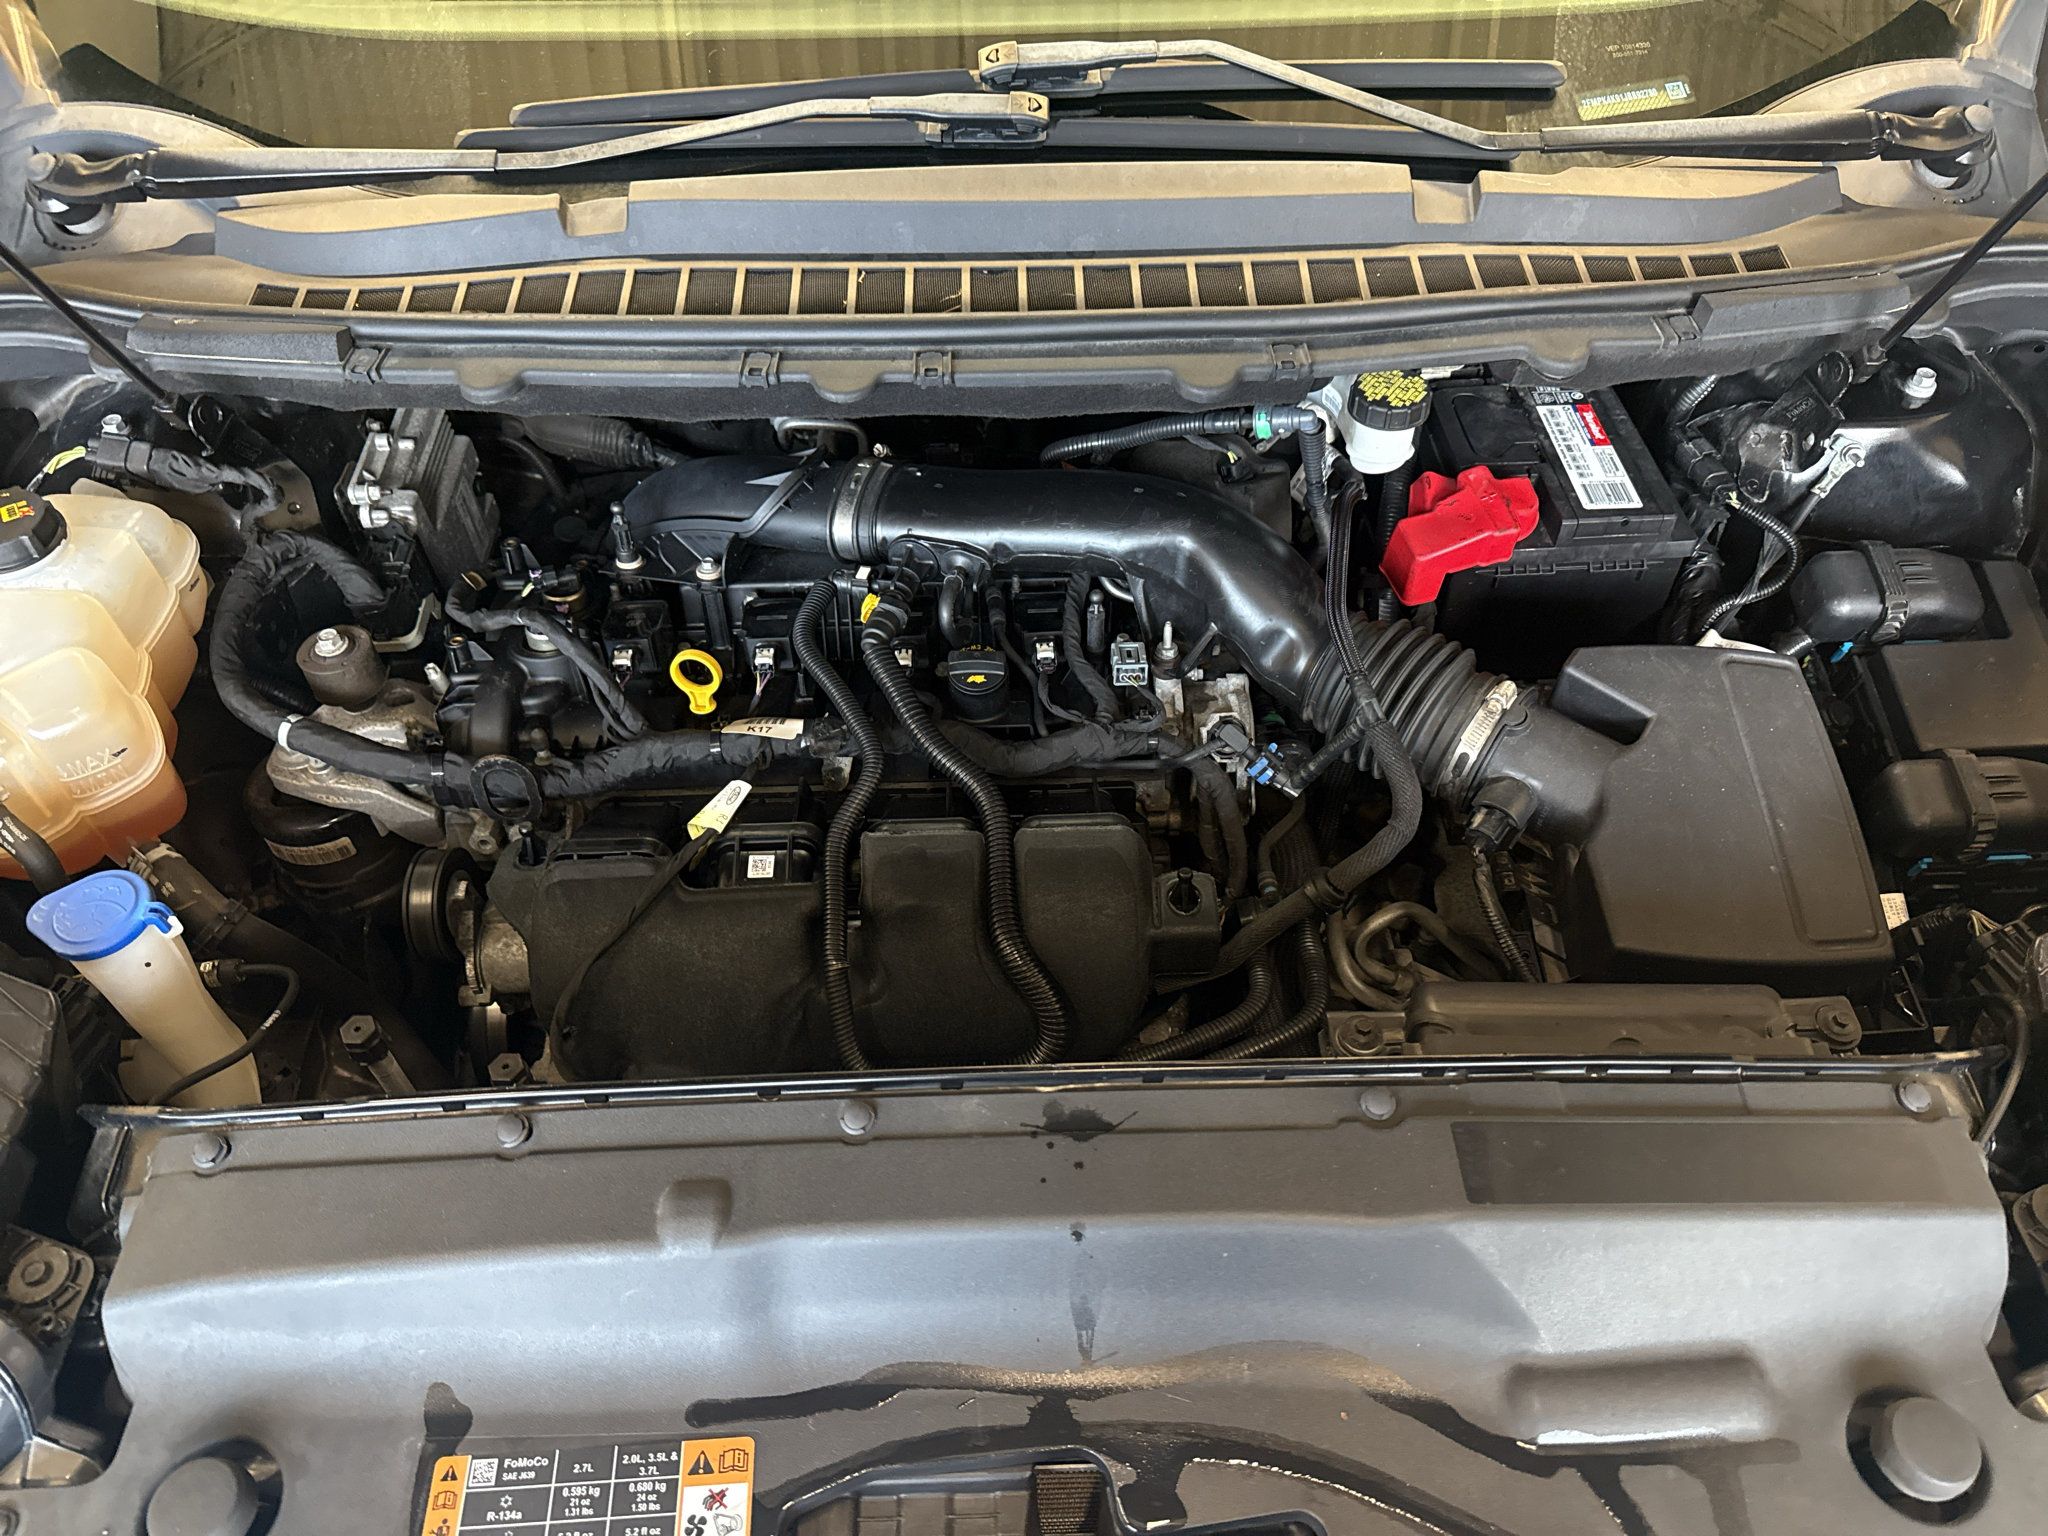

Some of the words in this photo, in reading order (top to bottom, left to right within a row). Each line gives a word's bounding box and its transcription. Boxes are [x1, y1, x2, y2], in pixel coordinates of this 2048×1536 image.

[746, 725, 773, 734] K17
[66, 748, 117, 777] MAX
[503, 1456, 549, 1469] FoMoCo
[622, 1454, 646, 1465] 2.0L,
[648, 1452, 669, 1463] 3.5L
[670, 1451, 679, 1461] &
[572, 1463, 595, 1474] 2.7L
[638, 1465, 660, 1476] 3.7L
[502, 1471, 518, 1481] SAE
[562, 1485, 588, 1498] 0.595
[588, 1485, 601, 1498] kg
[628, 1481, 654, 1493] 0.680
[654, 1480, 667, 1493] kg
[569, 1497, 580, 1507] 21
[580, 1498, 592, 1506] oz
[636, 1493, 646, 1502] 24
[647, 1493, 658, 1501] oz
[564, 1507, 581, 1517] 1.31
[581, 1506, 595, 1516] lbs
[631, 1502, 648, 1512] 1.50
[648, 1502, 662, 1511] lbs
[486, 1509, 523, 1522] R-134a
[649, 1527, 661, 1535] oz
